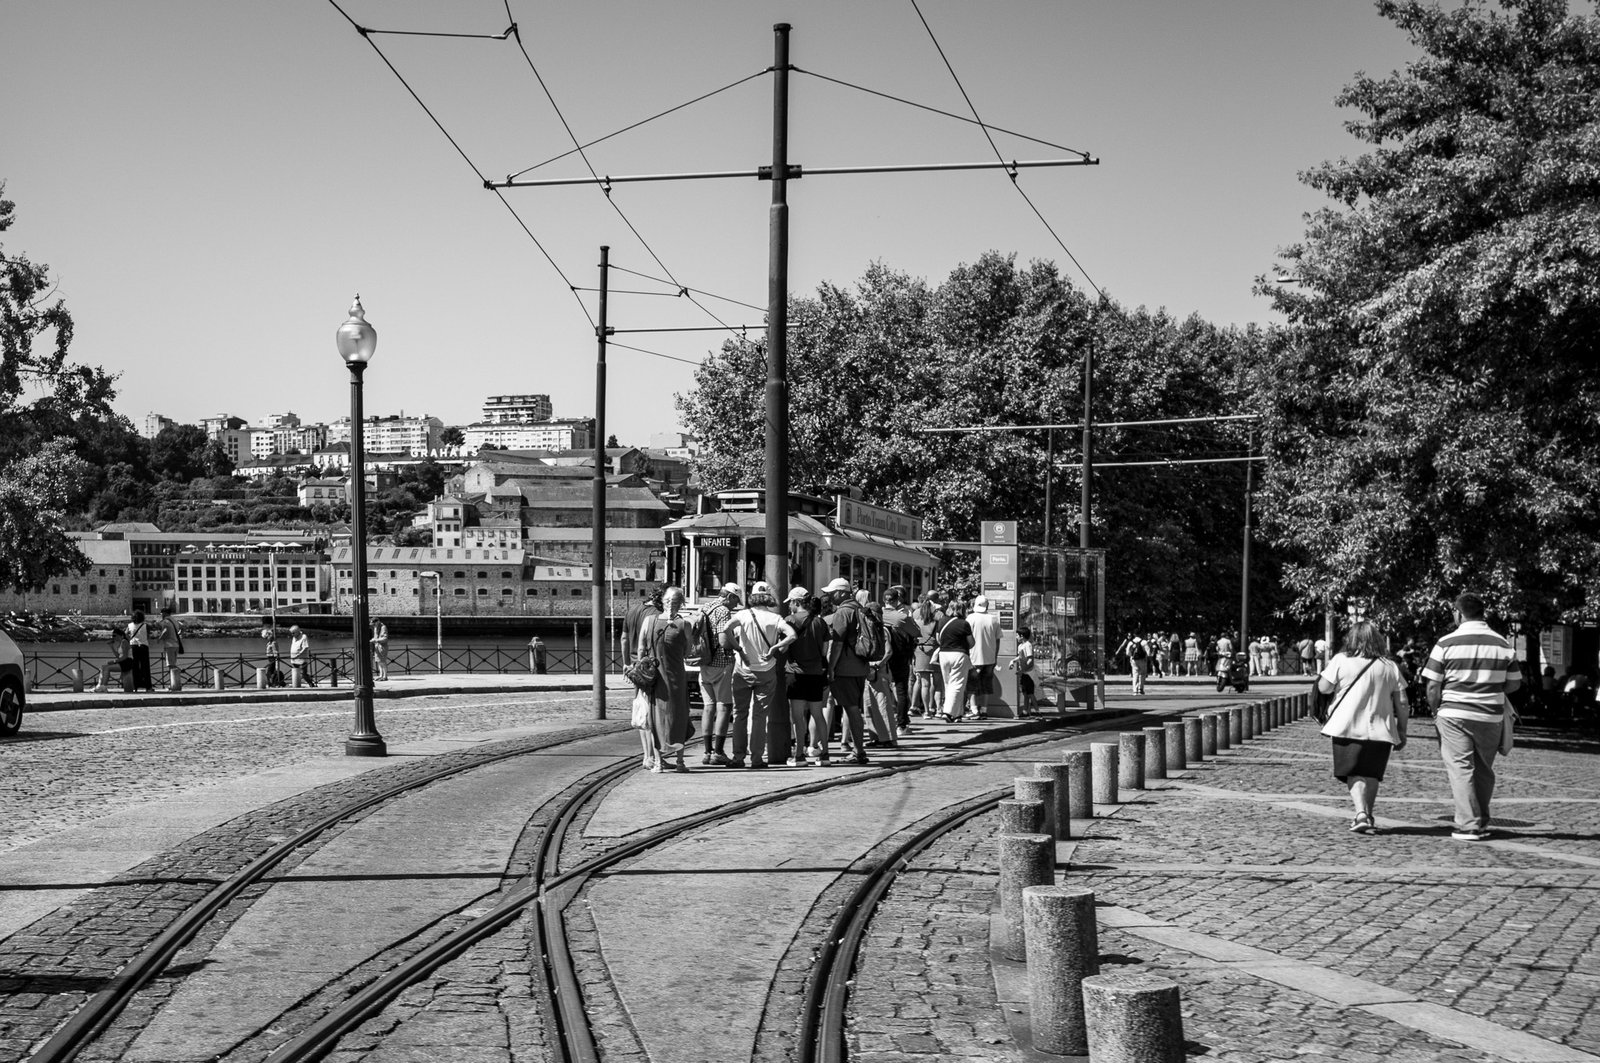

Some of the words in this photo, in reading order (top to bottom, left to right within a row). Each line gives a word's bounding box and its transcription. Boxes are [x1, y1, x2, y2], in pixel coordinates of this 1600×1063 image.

[857, 506, 871, 526] Porto
[871, 511, 886, 530] Tram
[700, 537, 731, 547] INFANTE
